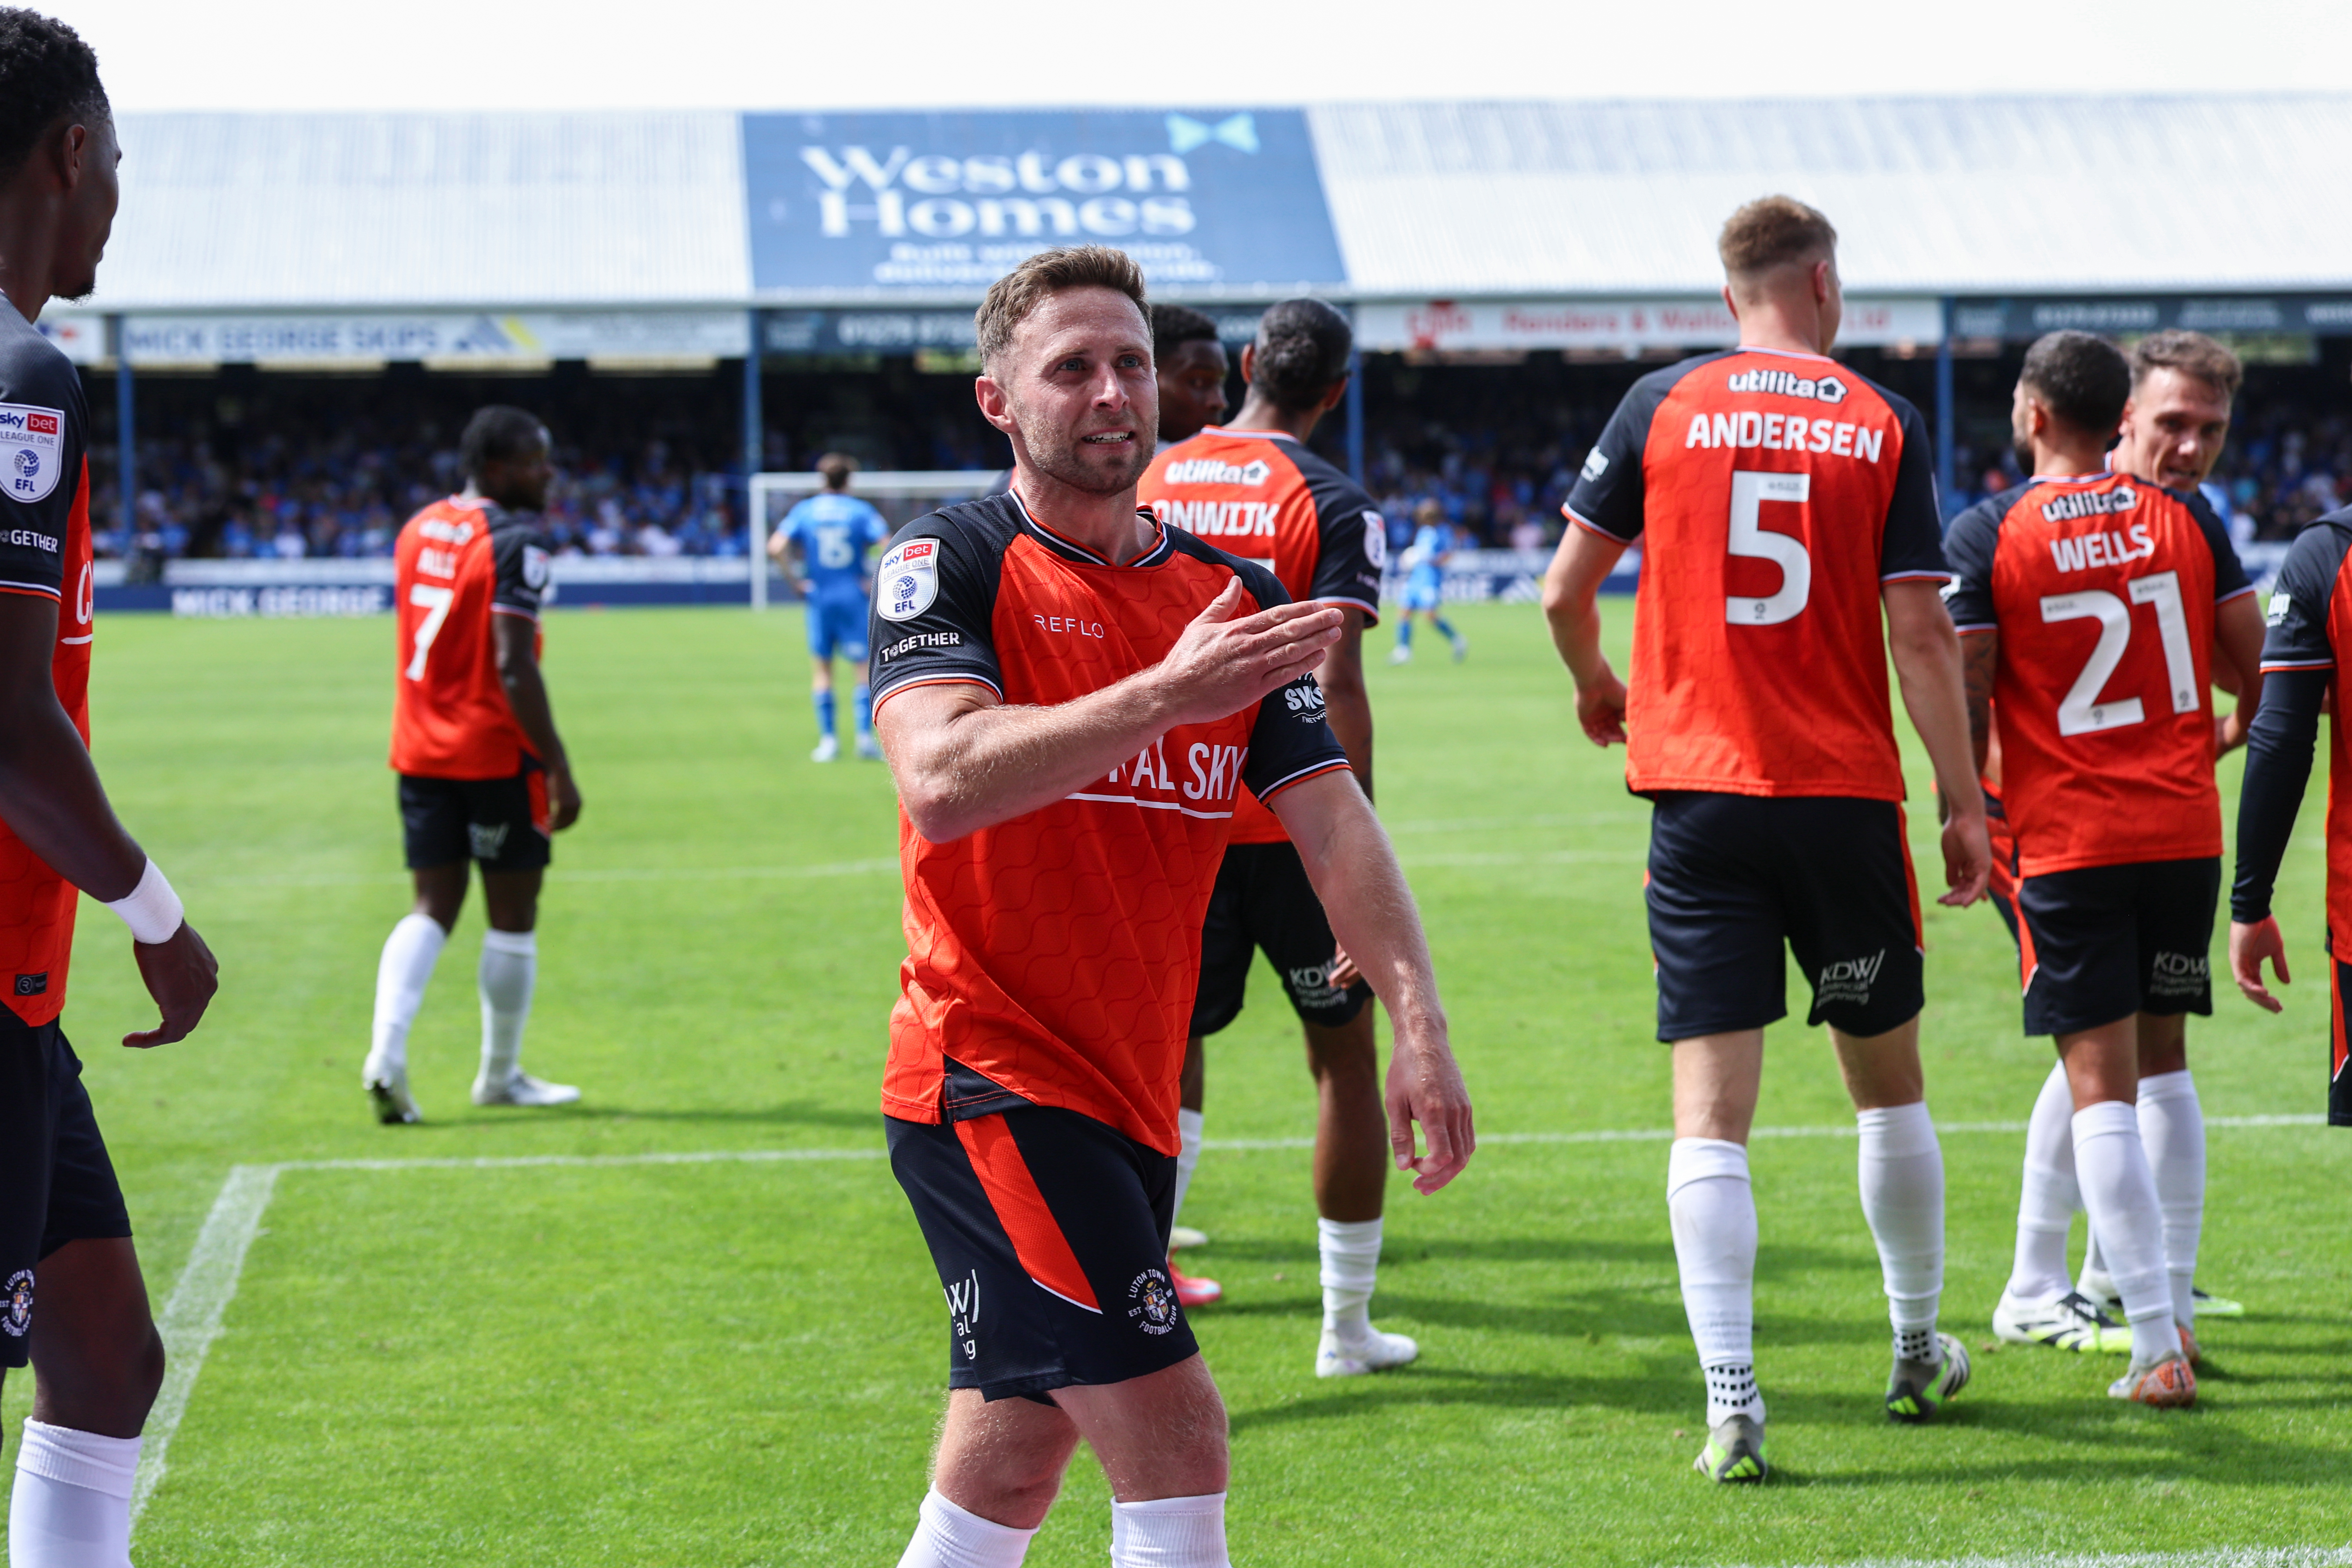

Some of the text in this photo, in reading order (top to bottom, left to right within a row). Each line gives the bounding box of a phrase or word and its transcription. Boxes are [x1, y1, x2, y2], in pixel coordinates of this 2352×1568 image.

[801, 146, 1190, 194] Weston
[821, 189, 1196, 238] Homes
[1728, 369, 1816, 399] utilita
[30, 415, 55, 431] bet
[0, 431, 55, 446] LEAGUE ONE
[1685, 412, 1883, 464] ANDERSEN
[15, 478, 35, 492] EFL
[1165, 460, 1242, 484] utilita
[1138, 499, 1280, 537] ONWIJK
[884, 545, 929, 568] sky bet
[1726, 470, 1811, 625] 5
[2050, 523, 2155, 573] WELLS
[884, 557, 929, 580] LEAGUE ONE
[895, 600, 915, 614] EFL
[405, 583, 454, 682] 7
[1034, 614, 1104, 639] REFLO
[2040, 570, 2200, 737] 21
[1182, 743, 1249, 800] SKY
[1128, 1269, 1165, 1298] LUTON TOWN
[1128, 1307, 1142, 1317] EST
[1139, 1321, 1172, 1335] FOOTBALL
